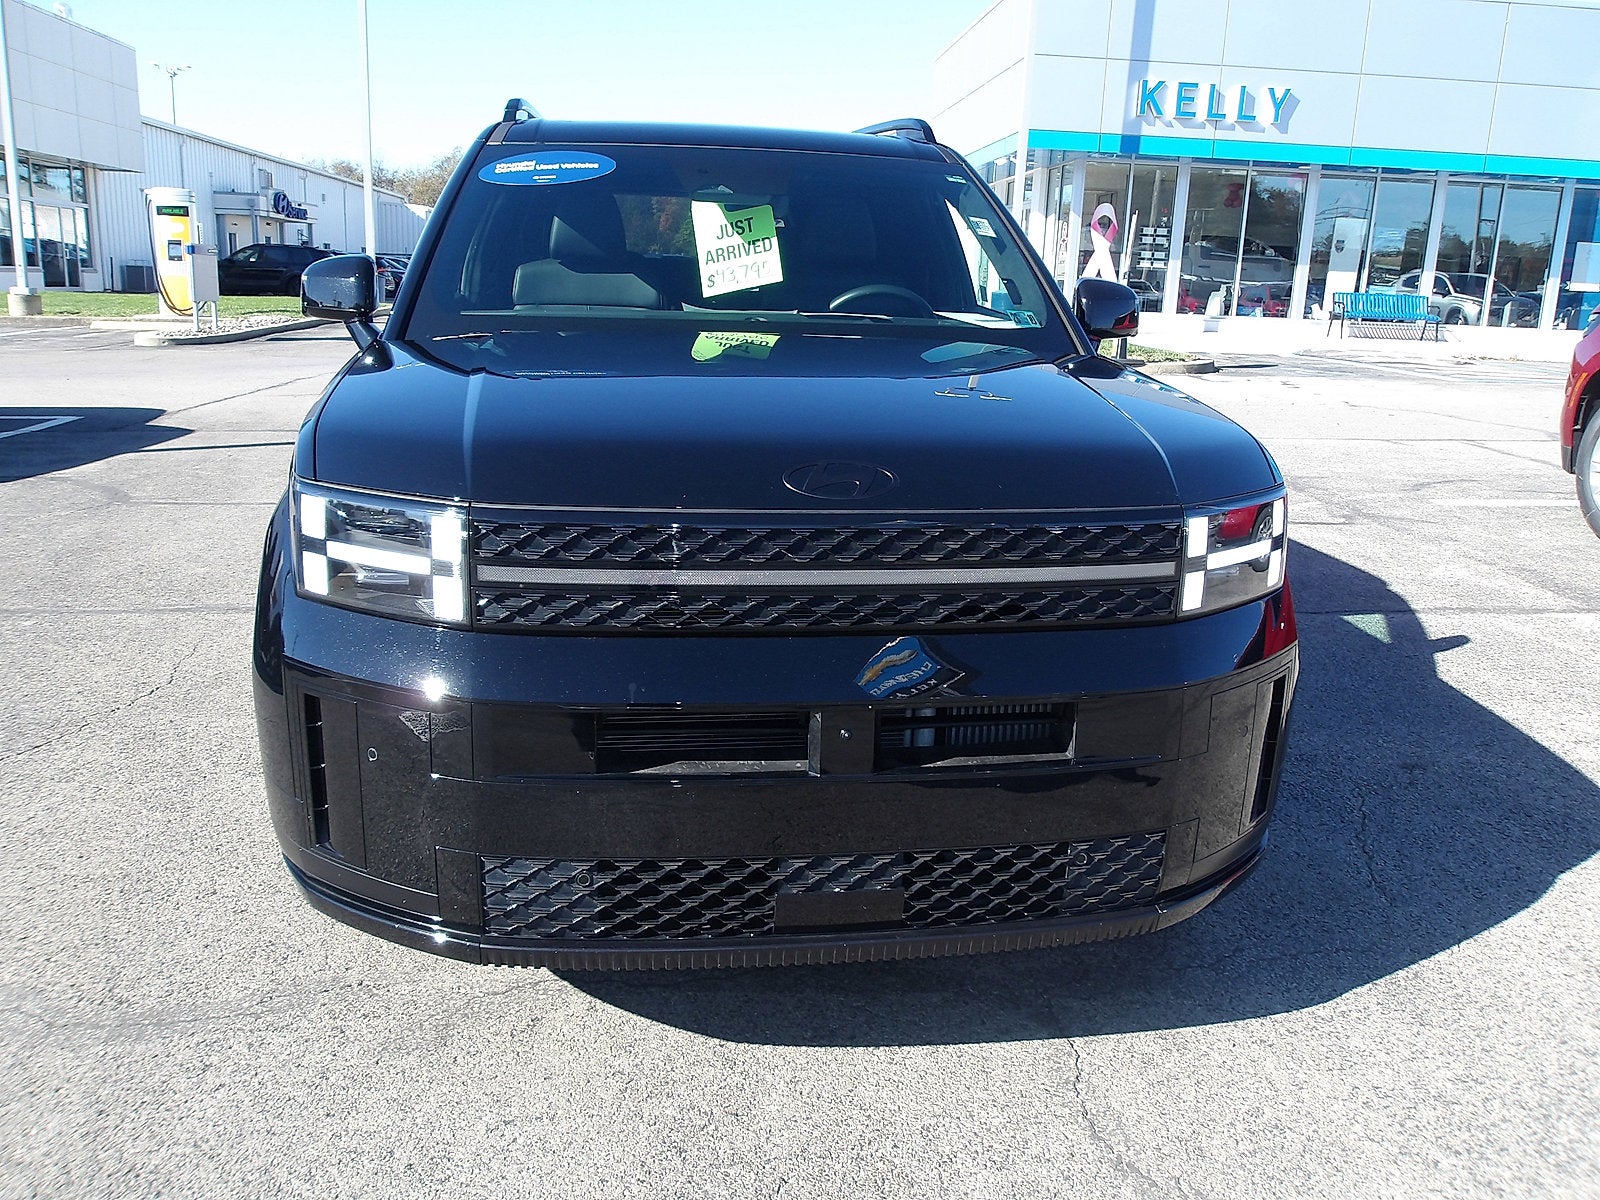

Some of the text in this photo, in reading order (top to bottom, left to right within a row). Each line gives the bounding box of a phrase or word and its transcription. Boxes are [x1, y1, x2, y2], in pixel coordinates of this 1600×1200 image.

[1137, 79, 1292, 124] KELLY
[536, 163, 560, 171] Used
[716, 217, 753, 240] JUST
[706, 237, 773, 265] ARRIVED
